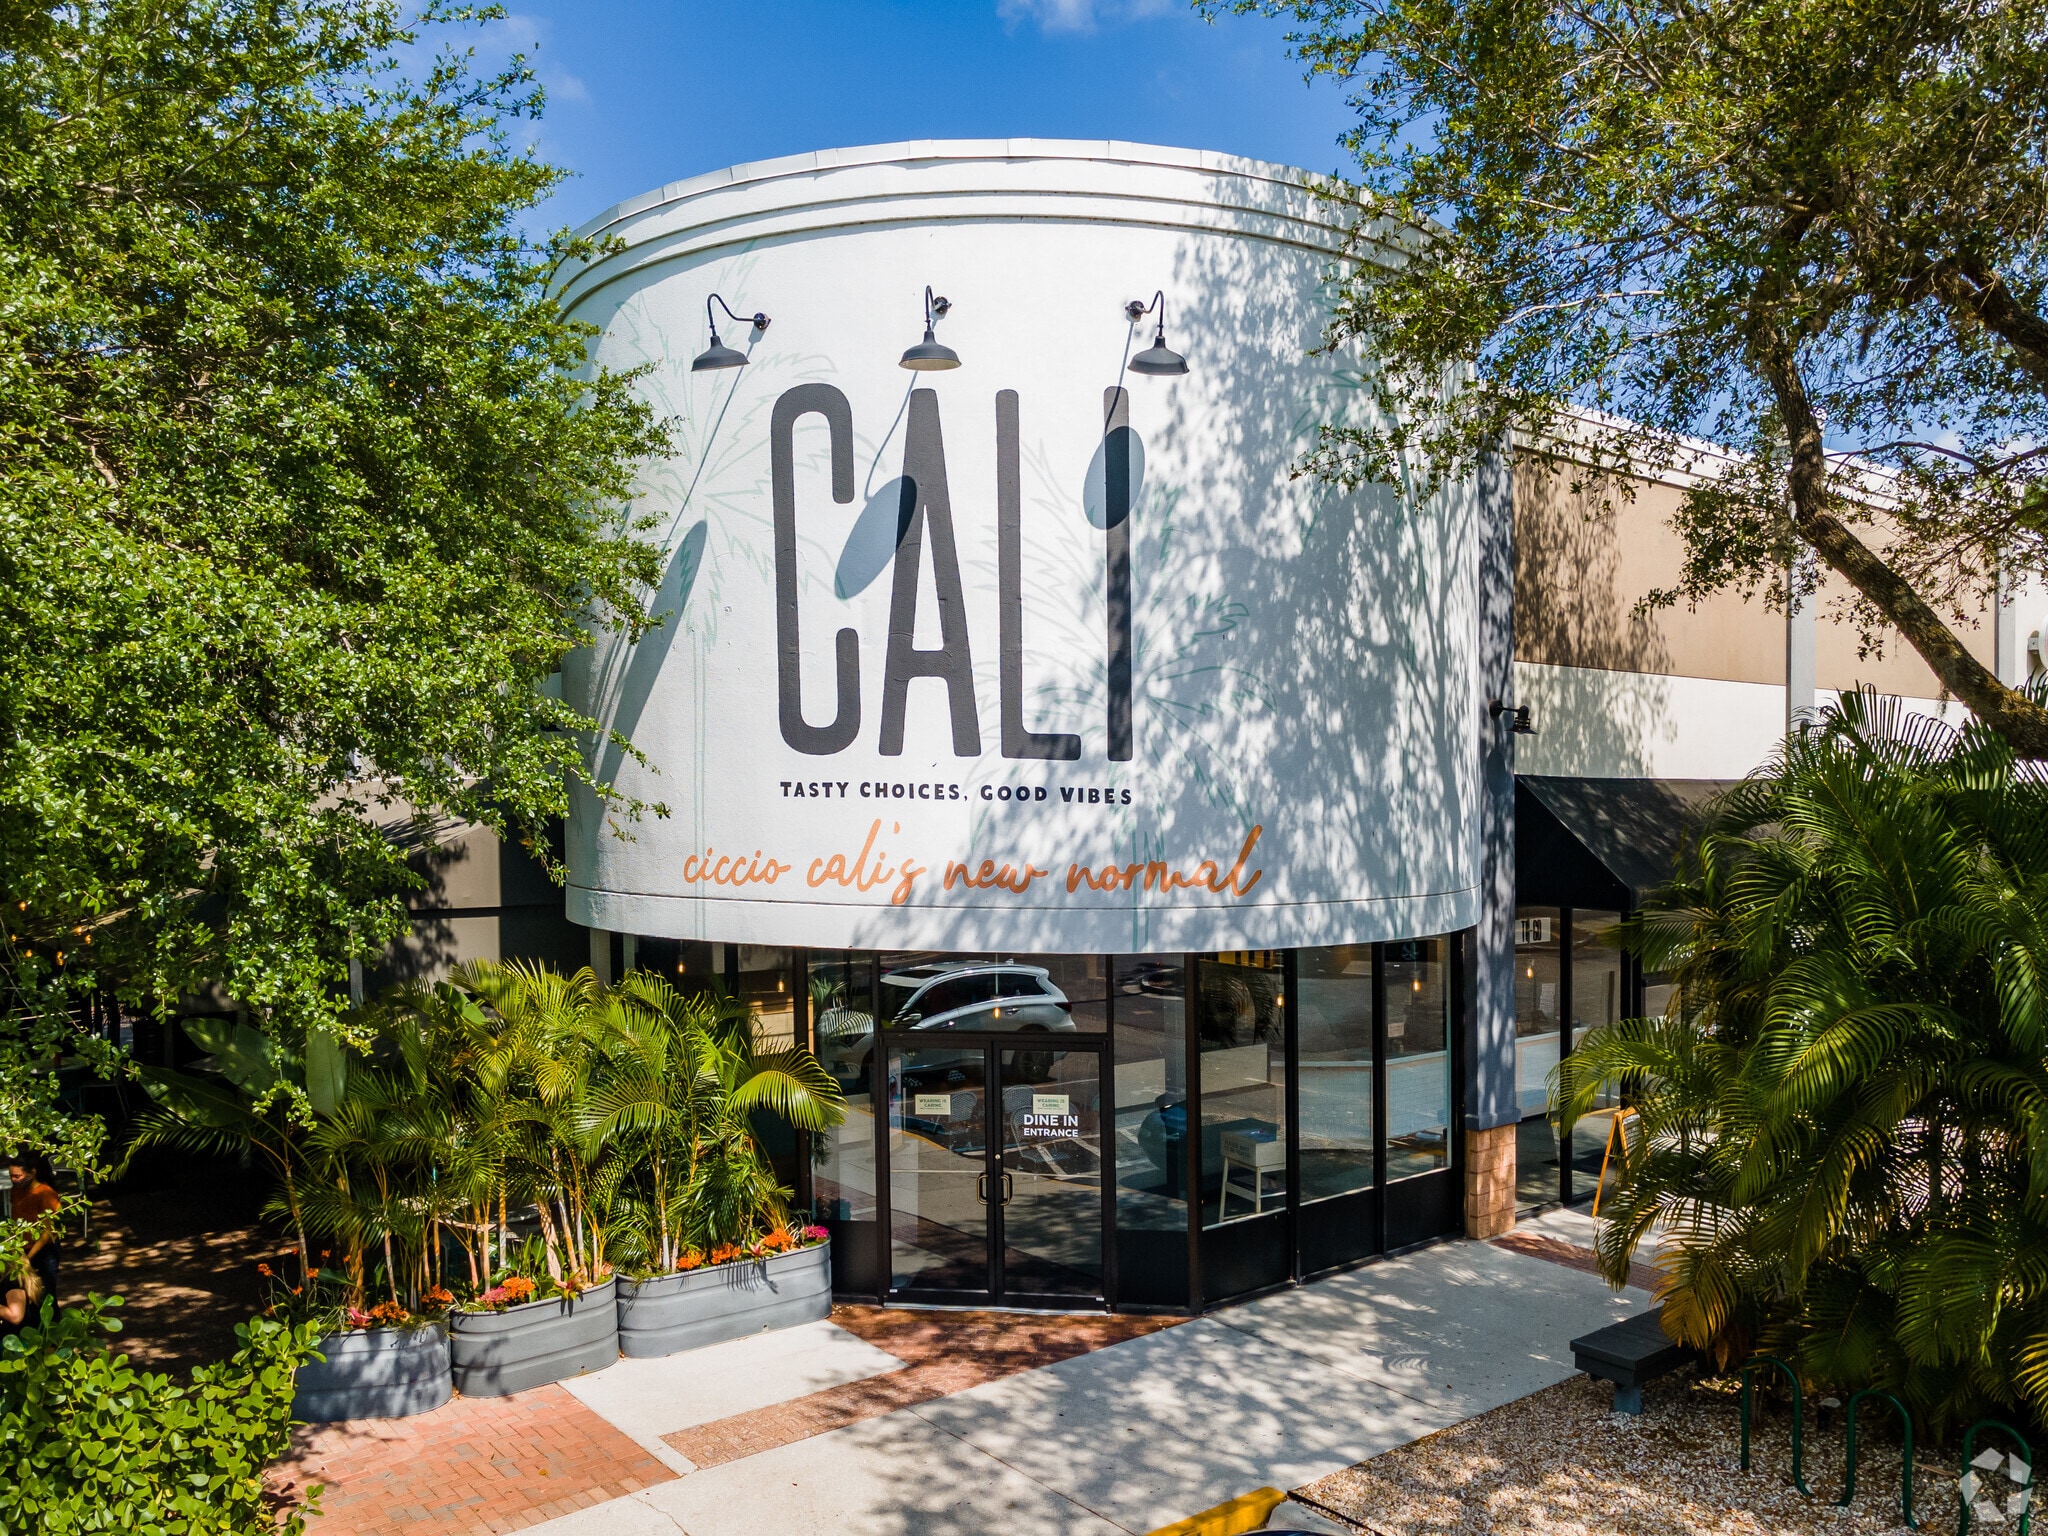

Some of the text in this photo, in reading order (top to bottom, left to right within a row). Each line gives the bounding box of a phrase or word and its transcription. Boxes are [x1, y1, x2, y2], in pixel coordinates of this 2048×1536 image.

[771, 382, 1133, 761] CALI
[780, 781, 1132, 805] TASTY CHOICES, GOOD VIBES
[683, 818, 1263, 906] ciccio cali's new normal
[1023, 1114, 1079, 1127] DINE IN
[1023, 1127, 1079, 1137] ENTRANCE
